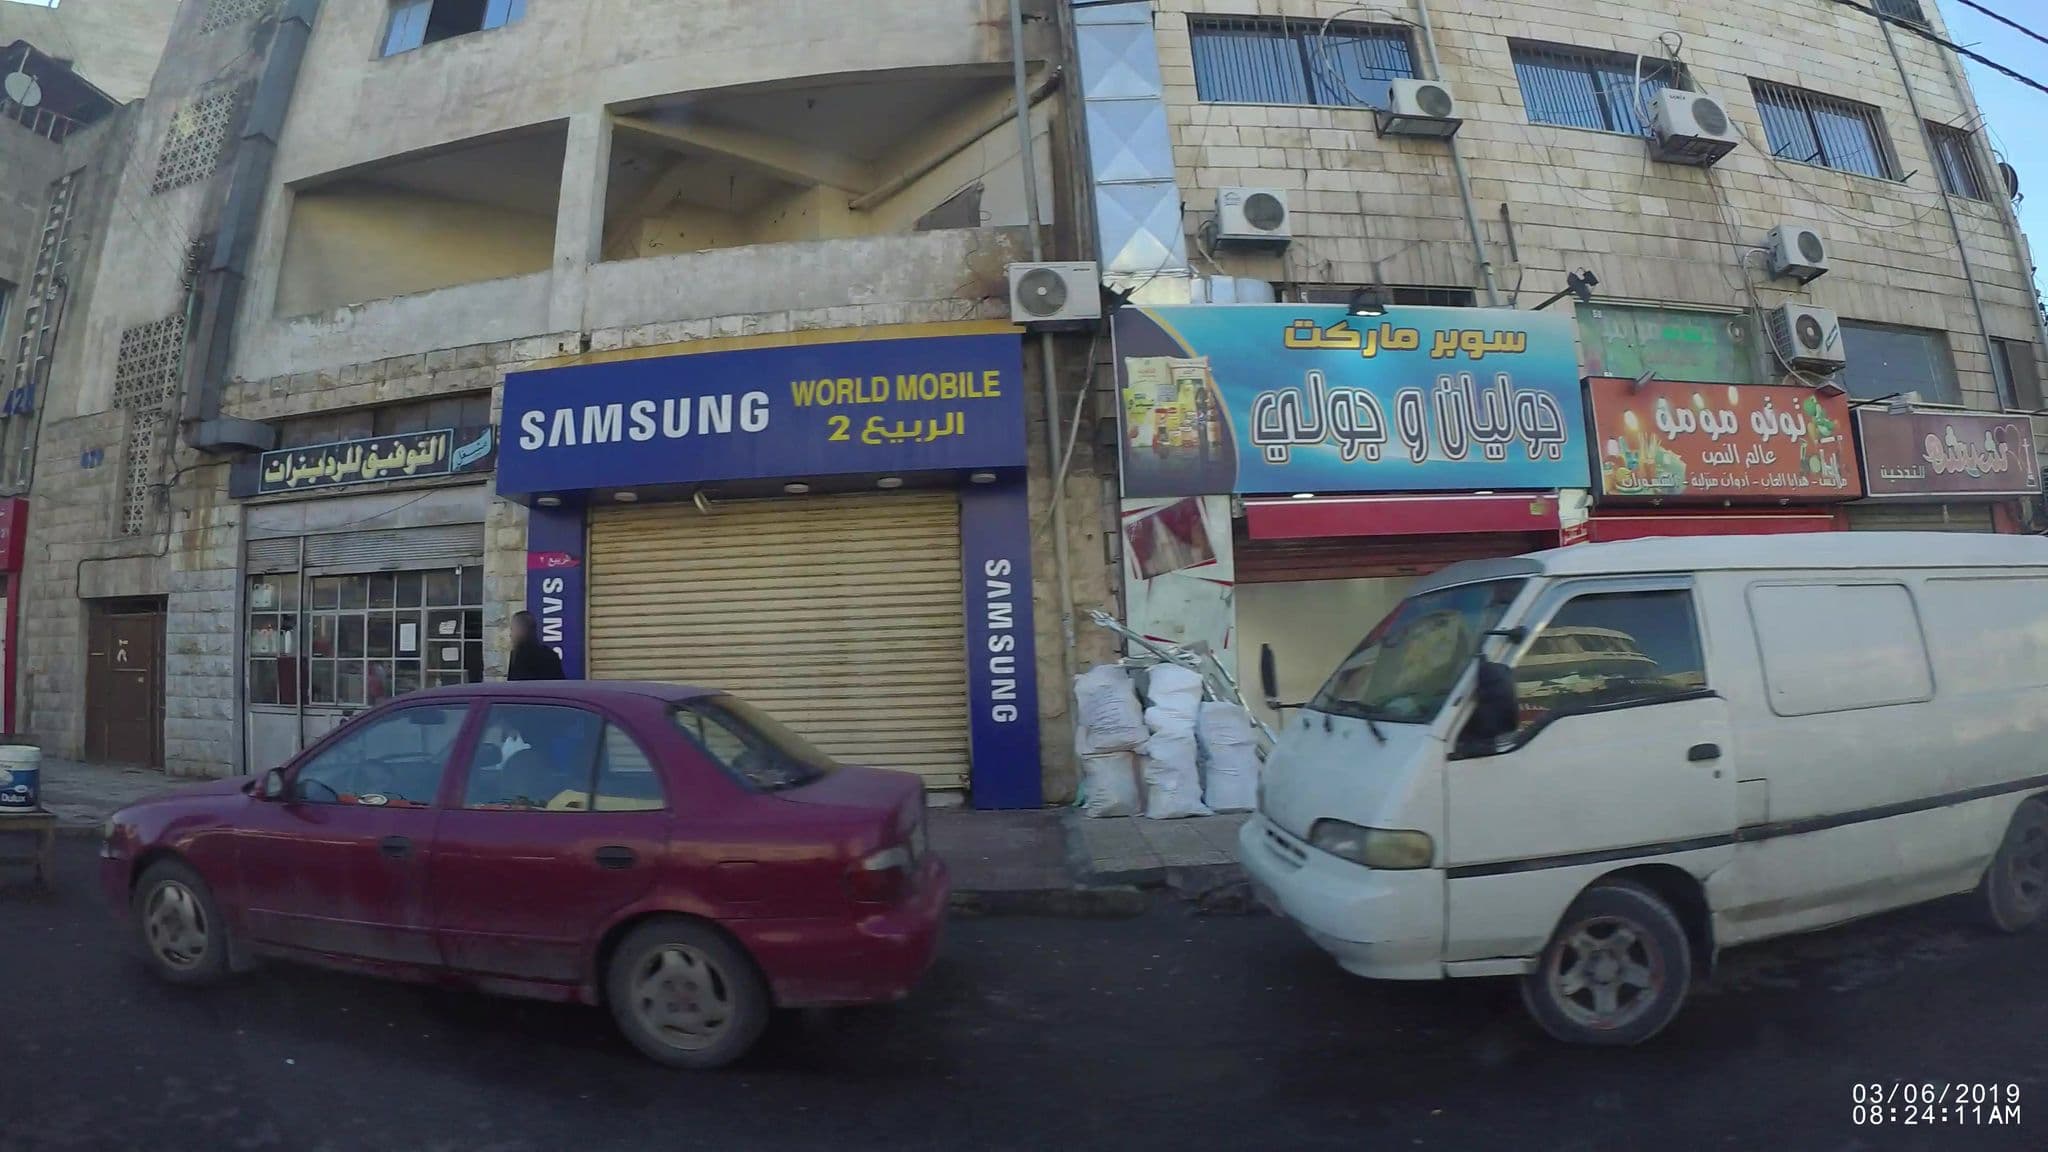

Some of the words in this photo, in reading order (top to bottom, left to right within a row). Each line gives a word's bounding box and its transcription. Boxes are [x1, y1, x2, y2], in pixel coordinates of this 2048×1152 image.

[1284, 318, 1420, 359] ماركت
[1430, 327, 1526, 360] سوبر
[792, 376, 889, 407] WORLD
[897, 370, 1001, 402] MOBILE
[519, 391, 770, 451] SAMSUNG
[828, 415, 851, 441] 2
[861, 410, 965, 446] الربيع
[1251, 369, 1387, 464] جولي
[1395, 386, 1430, 464] و
[1433, 371, 1568, 464] جوليان
[362, 434, 446, 480] التوفيق
[1745, 445, 1777, 468] عالم
[985, 559, 1018, 723] SAMSUNG
